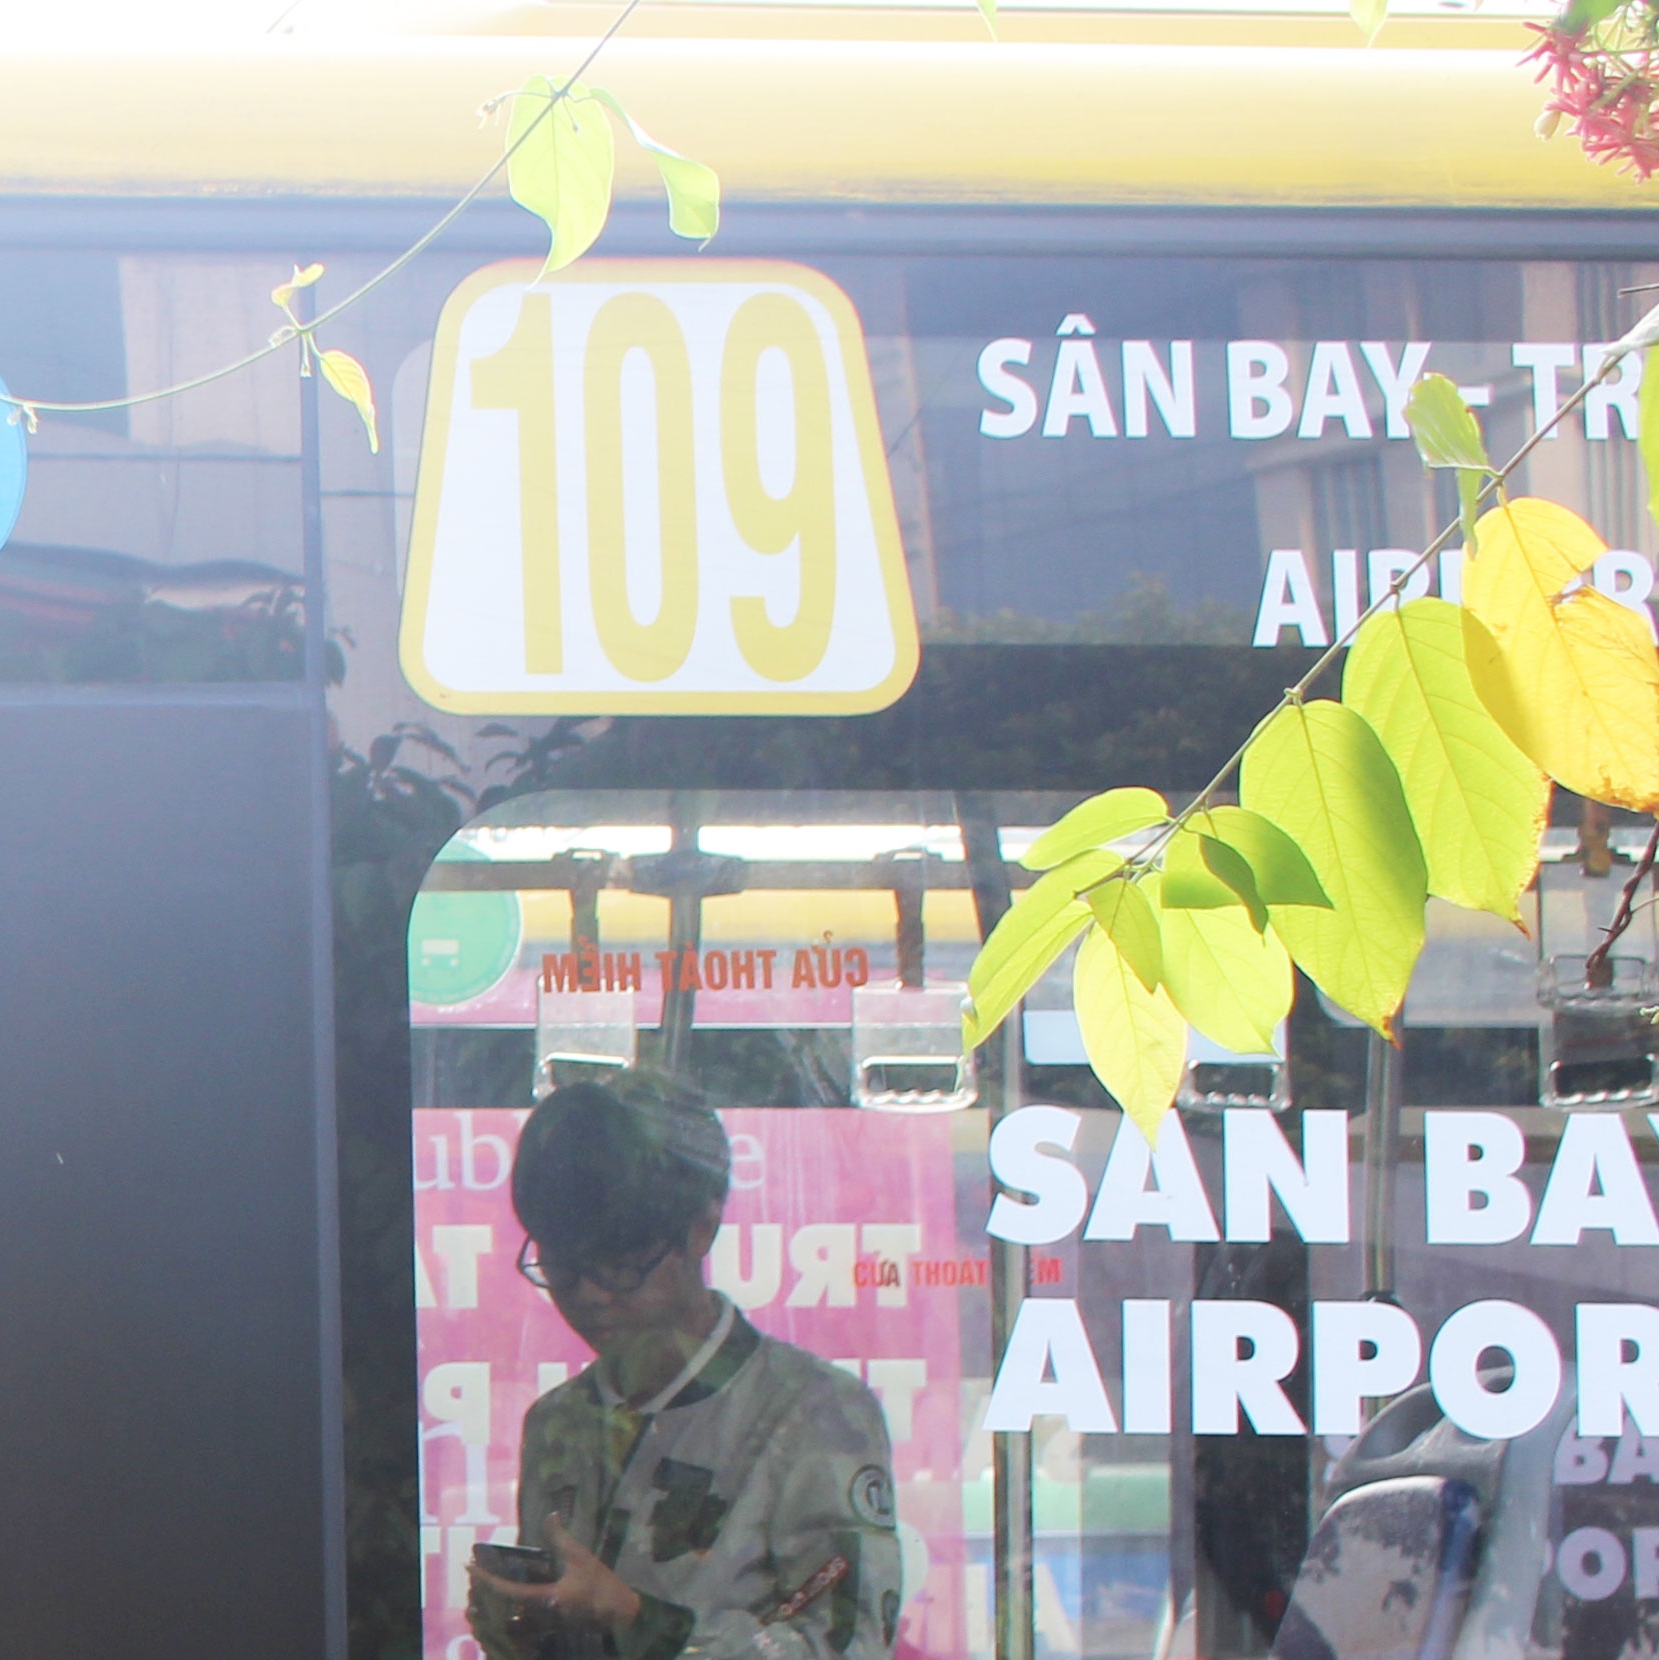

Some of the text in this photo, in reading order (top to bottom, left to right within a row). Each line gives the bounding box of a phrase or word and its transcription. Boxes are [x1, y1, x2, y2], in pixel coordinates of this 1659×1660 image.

[977, 312, 1196, 440] SÂN
[1227, 342, 1432, 440] BAY
[469, 291, 836, 682] 109
[1424, 1111, 1659, 1247] BA
